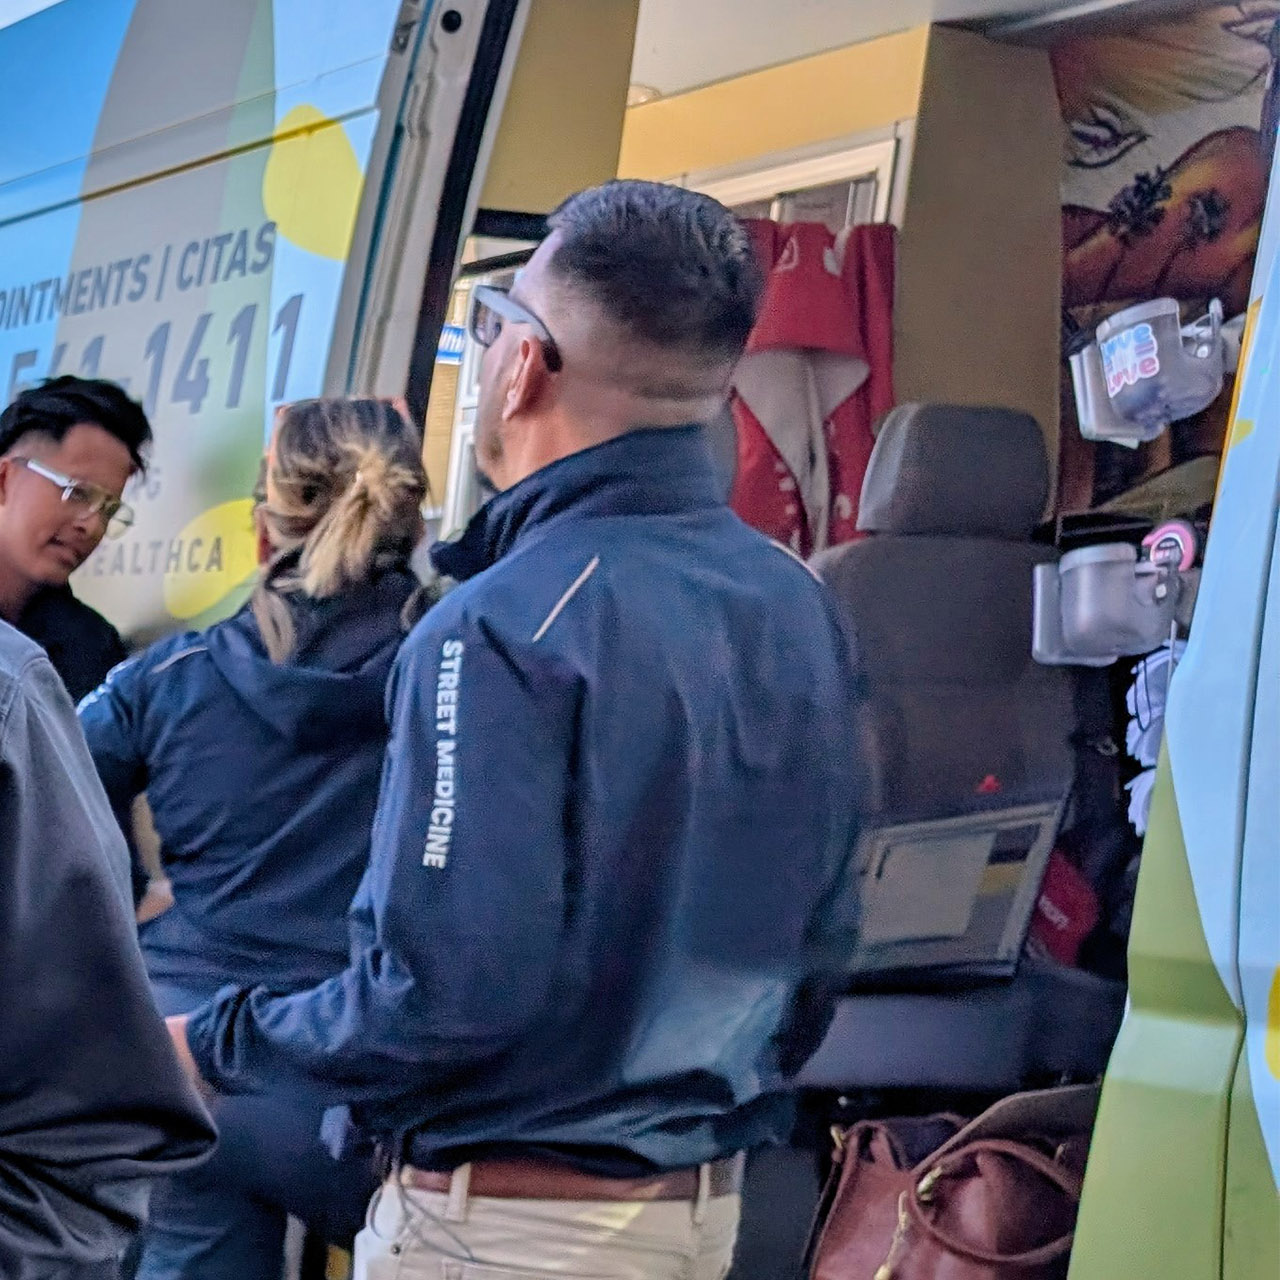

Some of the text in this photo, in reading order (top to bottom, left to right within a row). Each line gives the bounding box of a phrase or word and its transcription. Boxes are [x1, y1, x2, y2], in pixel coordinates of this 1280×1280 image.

[176, 221, 277, 291] CITAS
[421, 639, 465, 869] STREET MEDICINE
